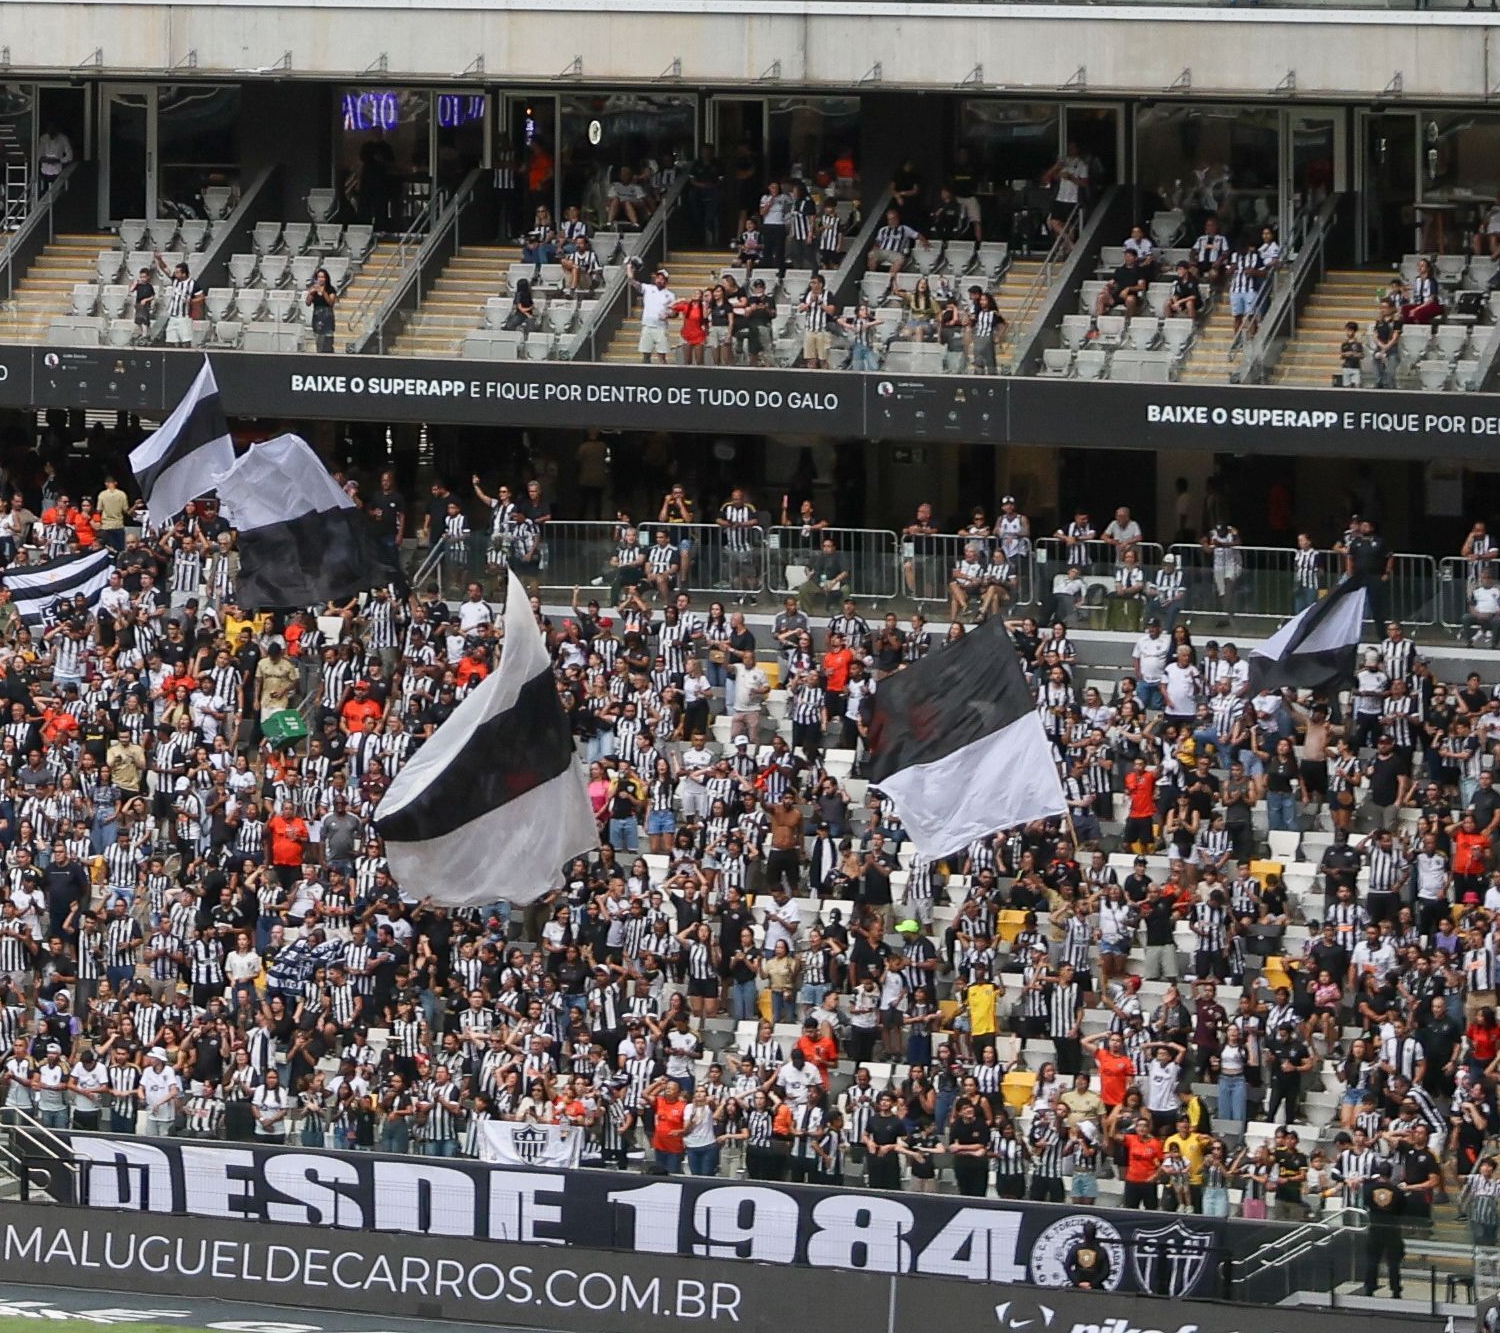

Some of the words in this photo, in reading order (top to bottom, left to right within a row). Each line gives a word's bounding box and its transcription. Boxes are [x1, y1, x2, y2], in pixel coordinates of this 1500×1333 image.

[291, 374, 347, 393] BAIXE
[350, 376, 365, 394] O
[367, 377, 466, 397] SUPERAPP
[470, 381, 481, 398] E
[486, 381, 540, 401] FIQUE
[544, 383, 582, 401] POR
[586, 384, 663, 404] DENTRO
[667, 387, 692, 405] DE
[696, 388, 750, 407] TUDO
[754, 390, 783, 408] DO
[787, 391, 839, 411] GALO
[1147, 404, 1209, 424] BAIXE
[1211, 407, 1228, 425] O
[1230, 407, 1339, 429] SUPERAPP
[1343, 411, 1355, 430] E
[1360, 412, 1420, 433] FIQUE
[1424, 414, 1466, 434] POR
[70, 1136, 567, 1244] DESDE
[607, 1182, 1029, 1284] 1984
